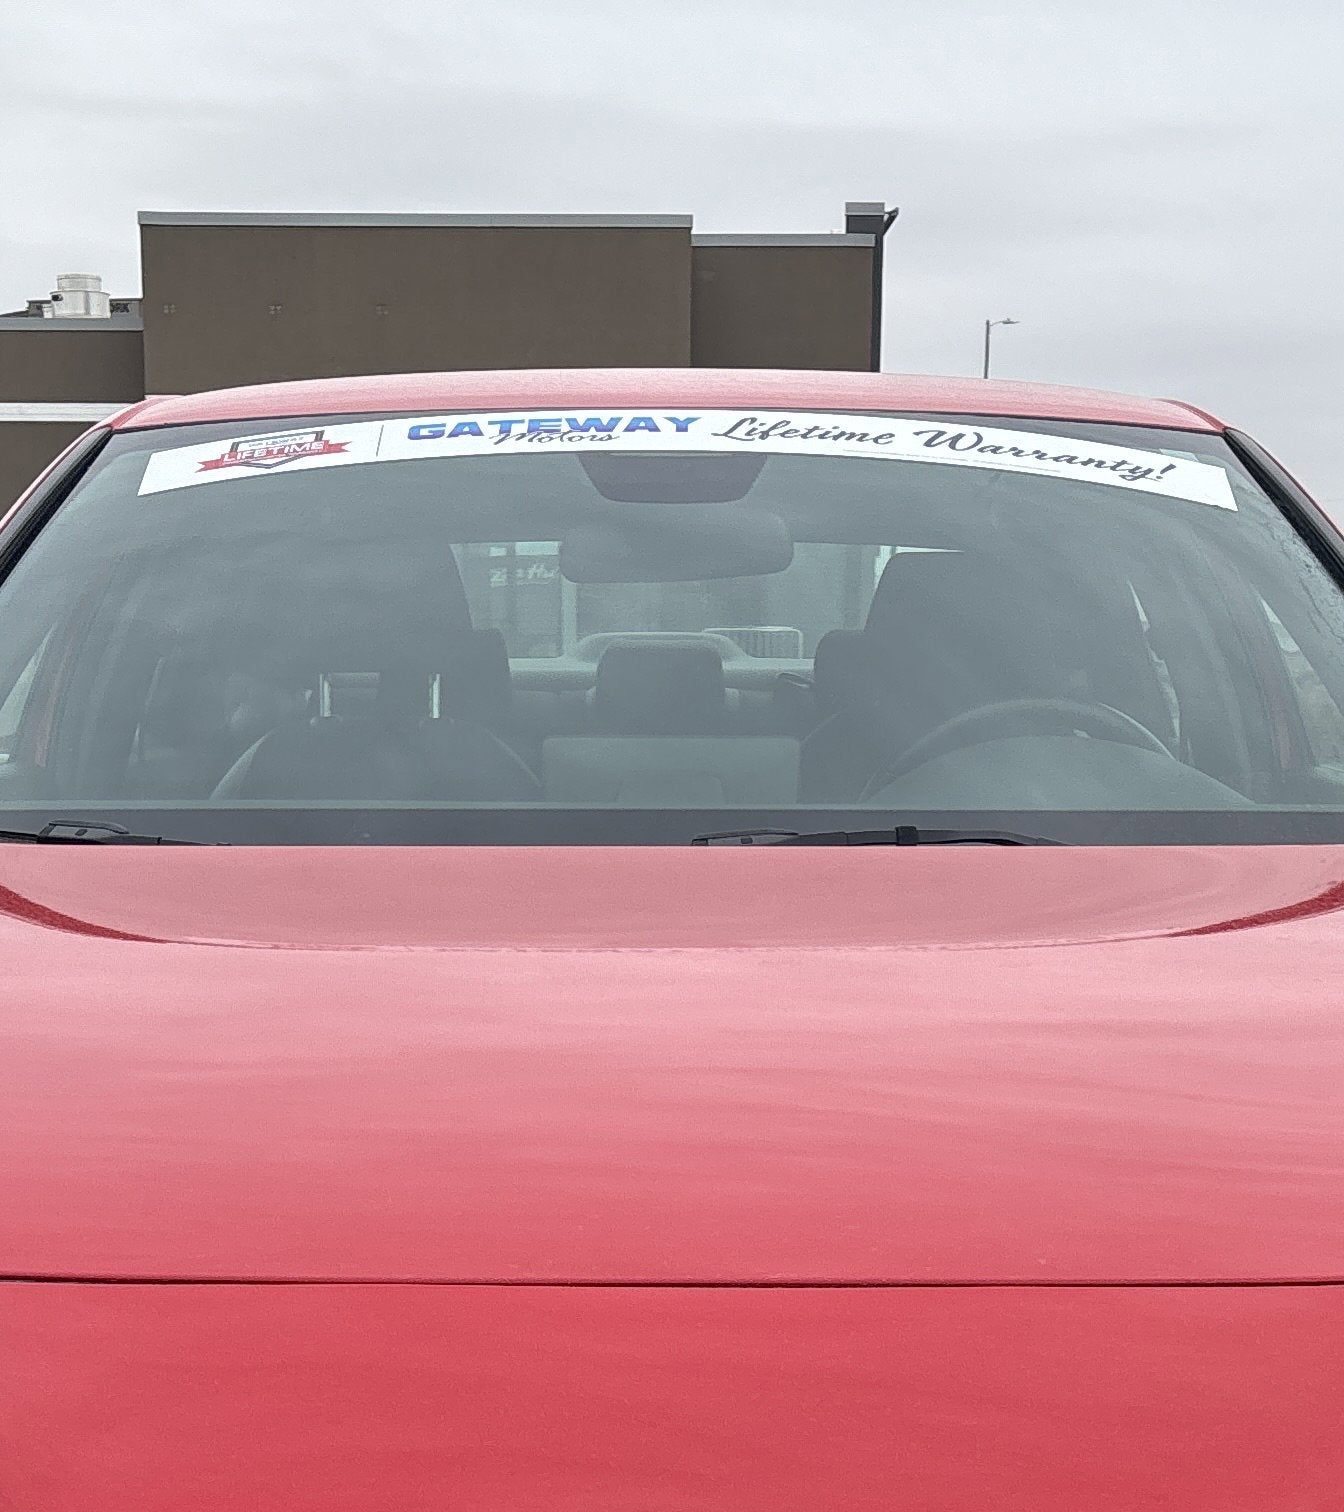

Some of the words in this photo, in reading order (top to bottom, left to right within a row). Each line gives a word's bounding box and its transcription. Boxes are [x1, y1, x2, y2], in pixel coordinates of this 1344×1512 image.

[407, 416, 703, 440] GATEWAY
[489, 429, 620, 445] Motors
[222, 440, 325, 463] LIFETIME
[712, 416, 894, 446] Lifetime
[913, 428, 1176, 482] Warranty!
